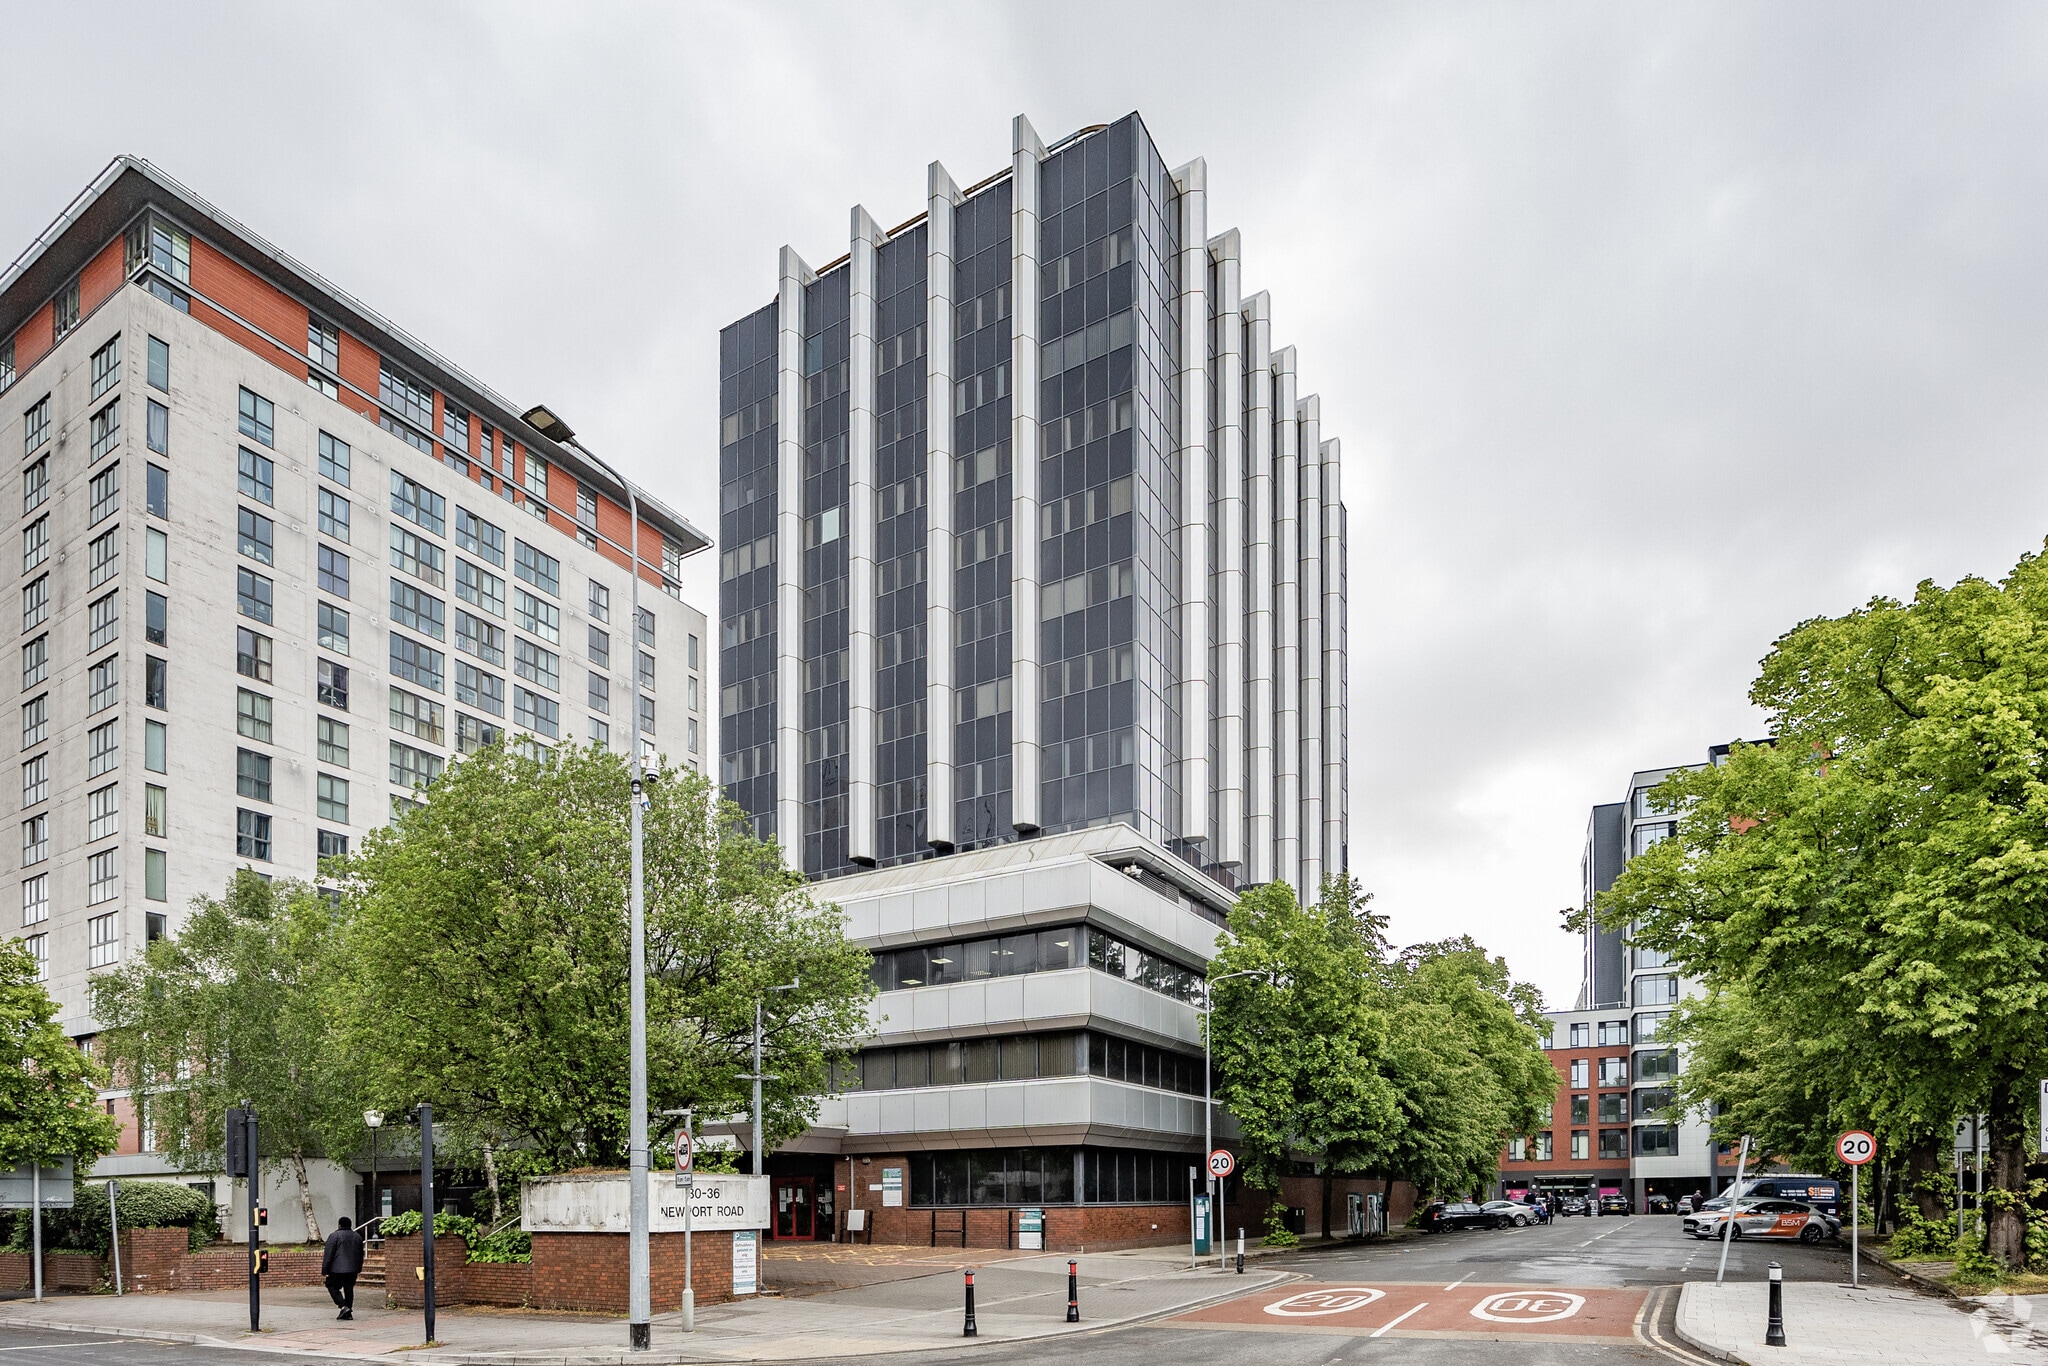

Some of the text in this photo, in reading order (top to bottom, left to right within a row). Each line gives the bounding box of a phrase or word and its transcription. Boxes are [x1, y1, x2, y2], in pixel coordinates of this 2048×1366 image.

[1843, 1140, 1870, 1154] 20
[1211, 1158, 1230, 1169] 20
[689, 1187, 721, 1199] 30-36
[660, 1205, 744, 1218] NEWORT ROAD
[1781, 1219, 1800, 1227] BSM
[1285, 1295, 1368, 1308] 20
[1489, 1298, 1568, 1312] 30
